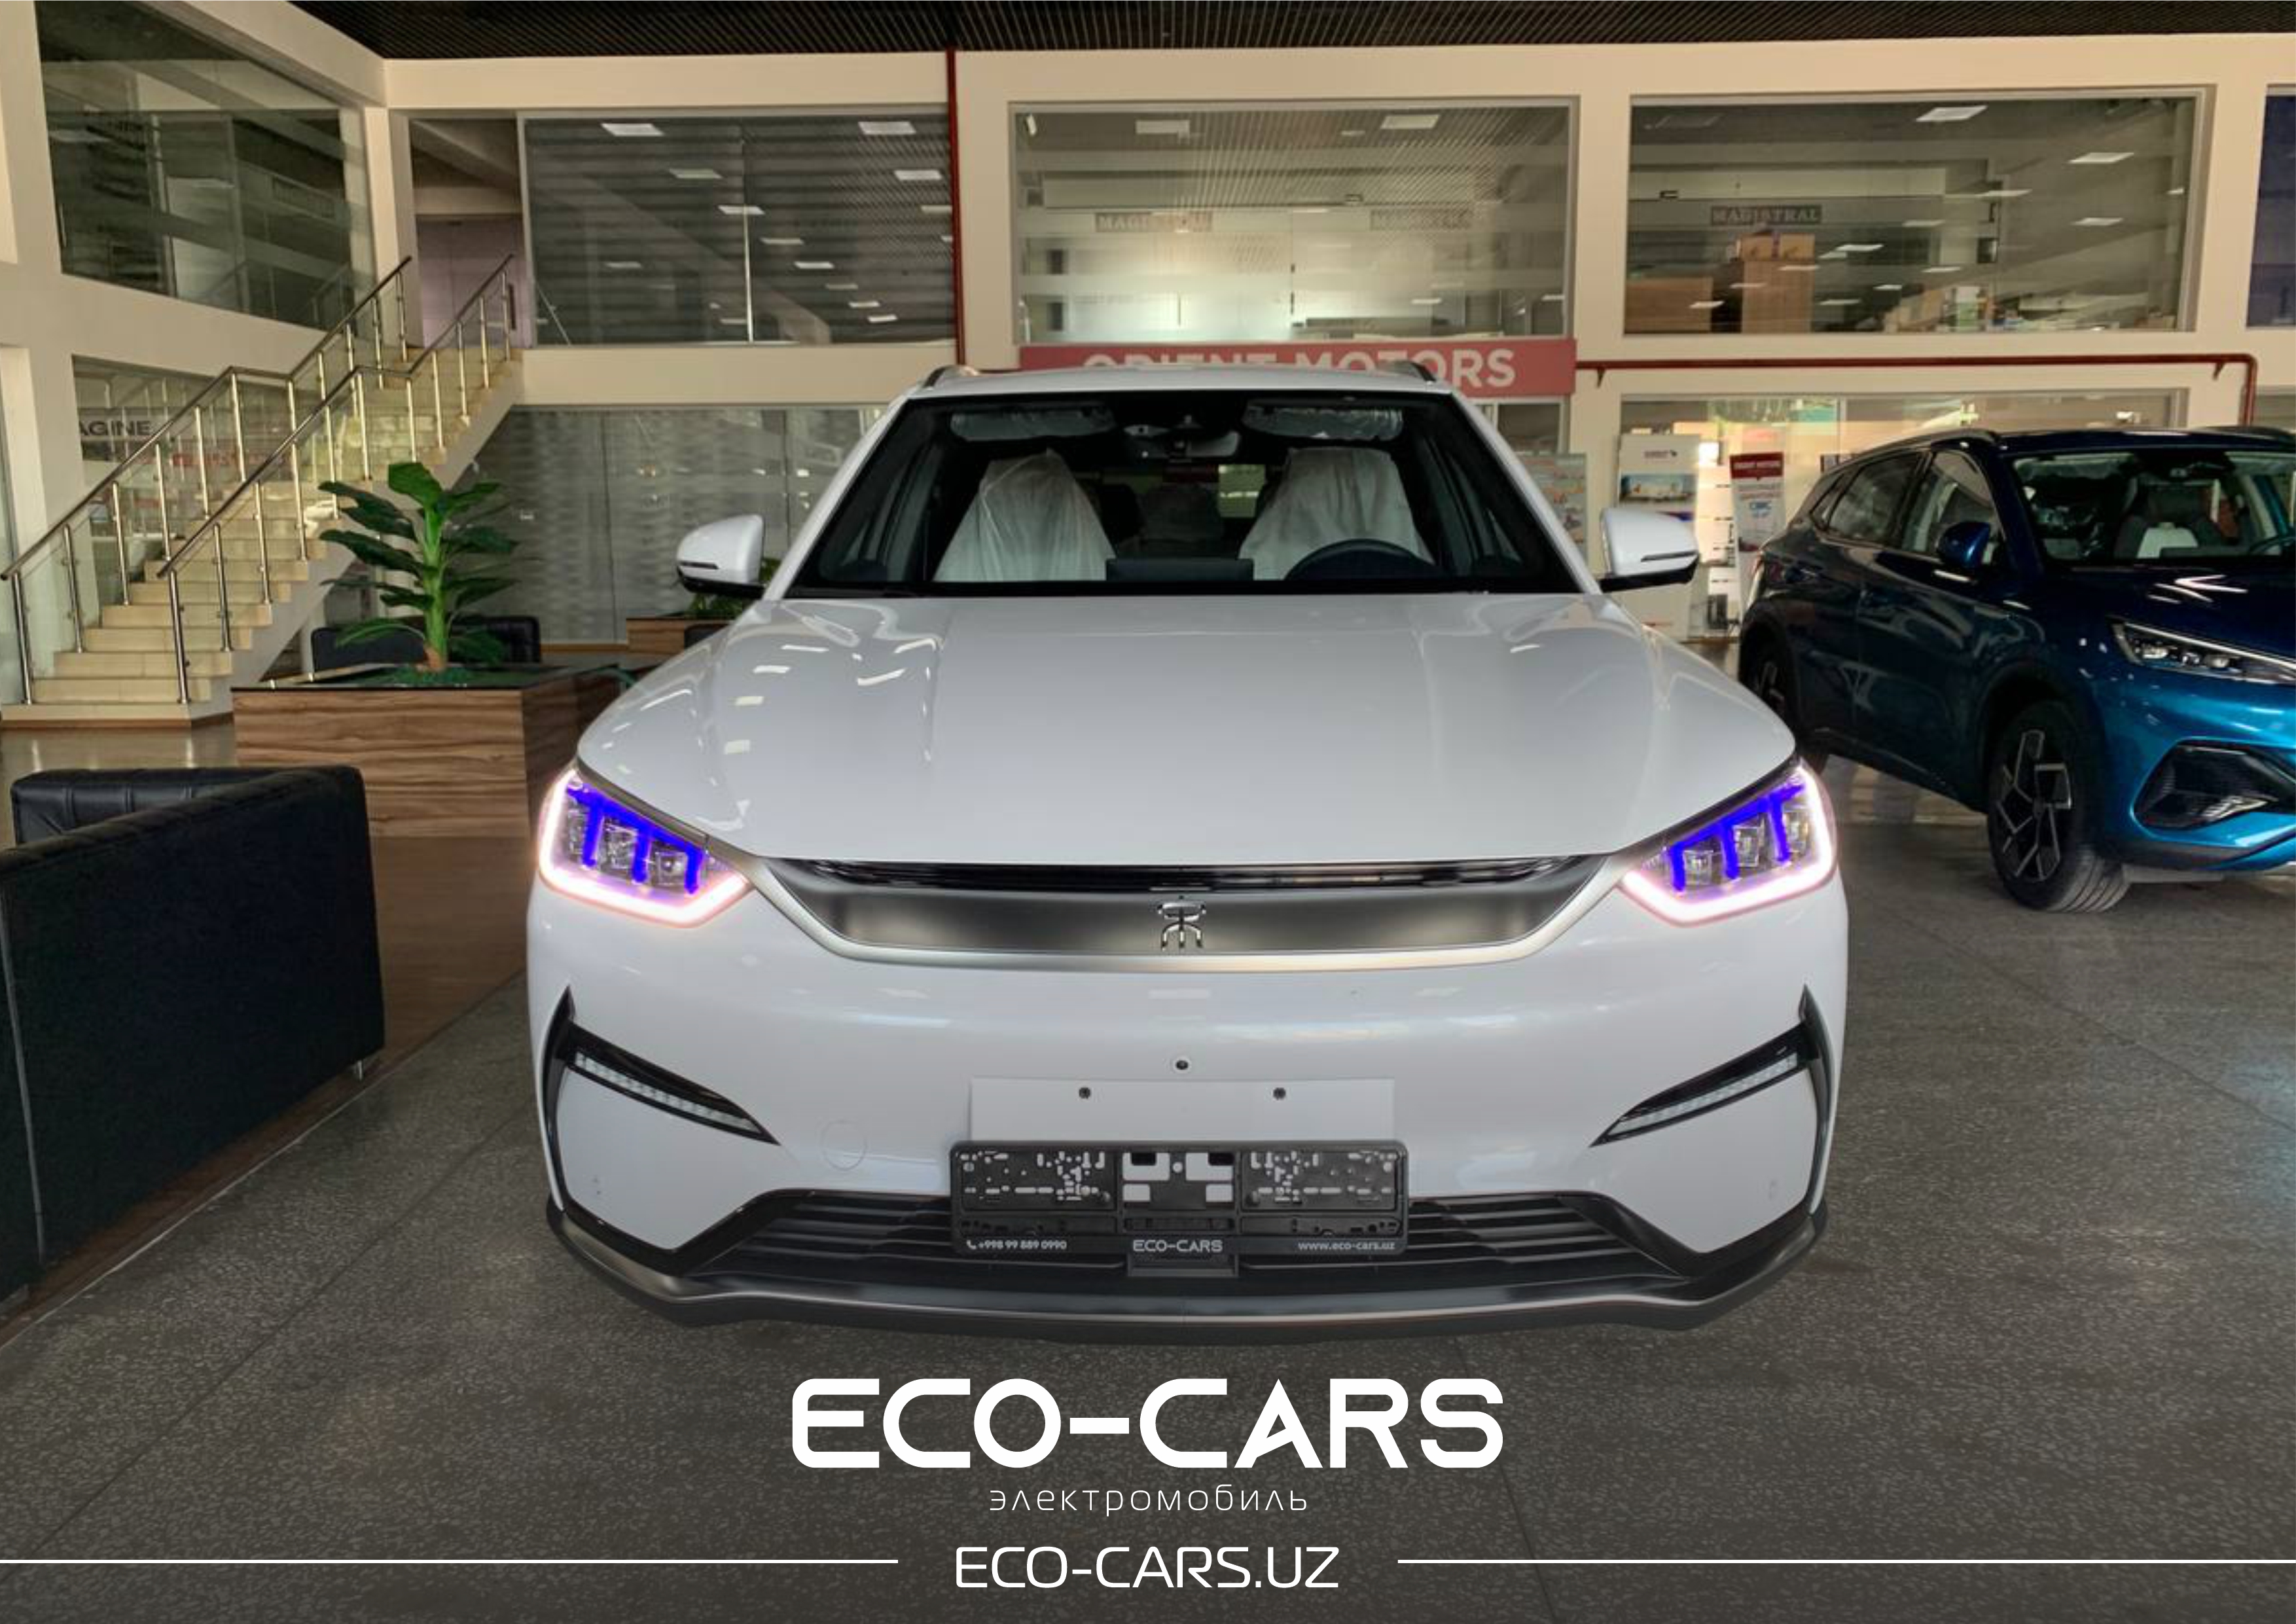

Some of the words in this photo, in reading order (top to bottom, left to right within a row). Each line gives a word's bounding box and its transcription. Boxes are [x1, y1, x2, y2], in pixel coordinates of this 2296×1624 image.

[1005, 1240, 1018, 1250] 99
[1134, 1240, 1222, 1252] ECO-CARS
[1297, 1241, 1395, 1250] www.eco-cars.uz
